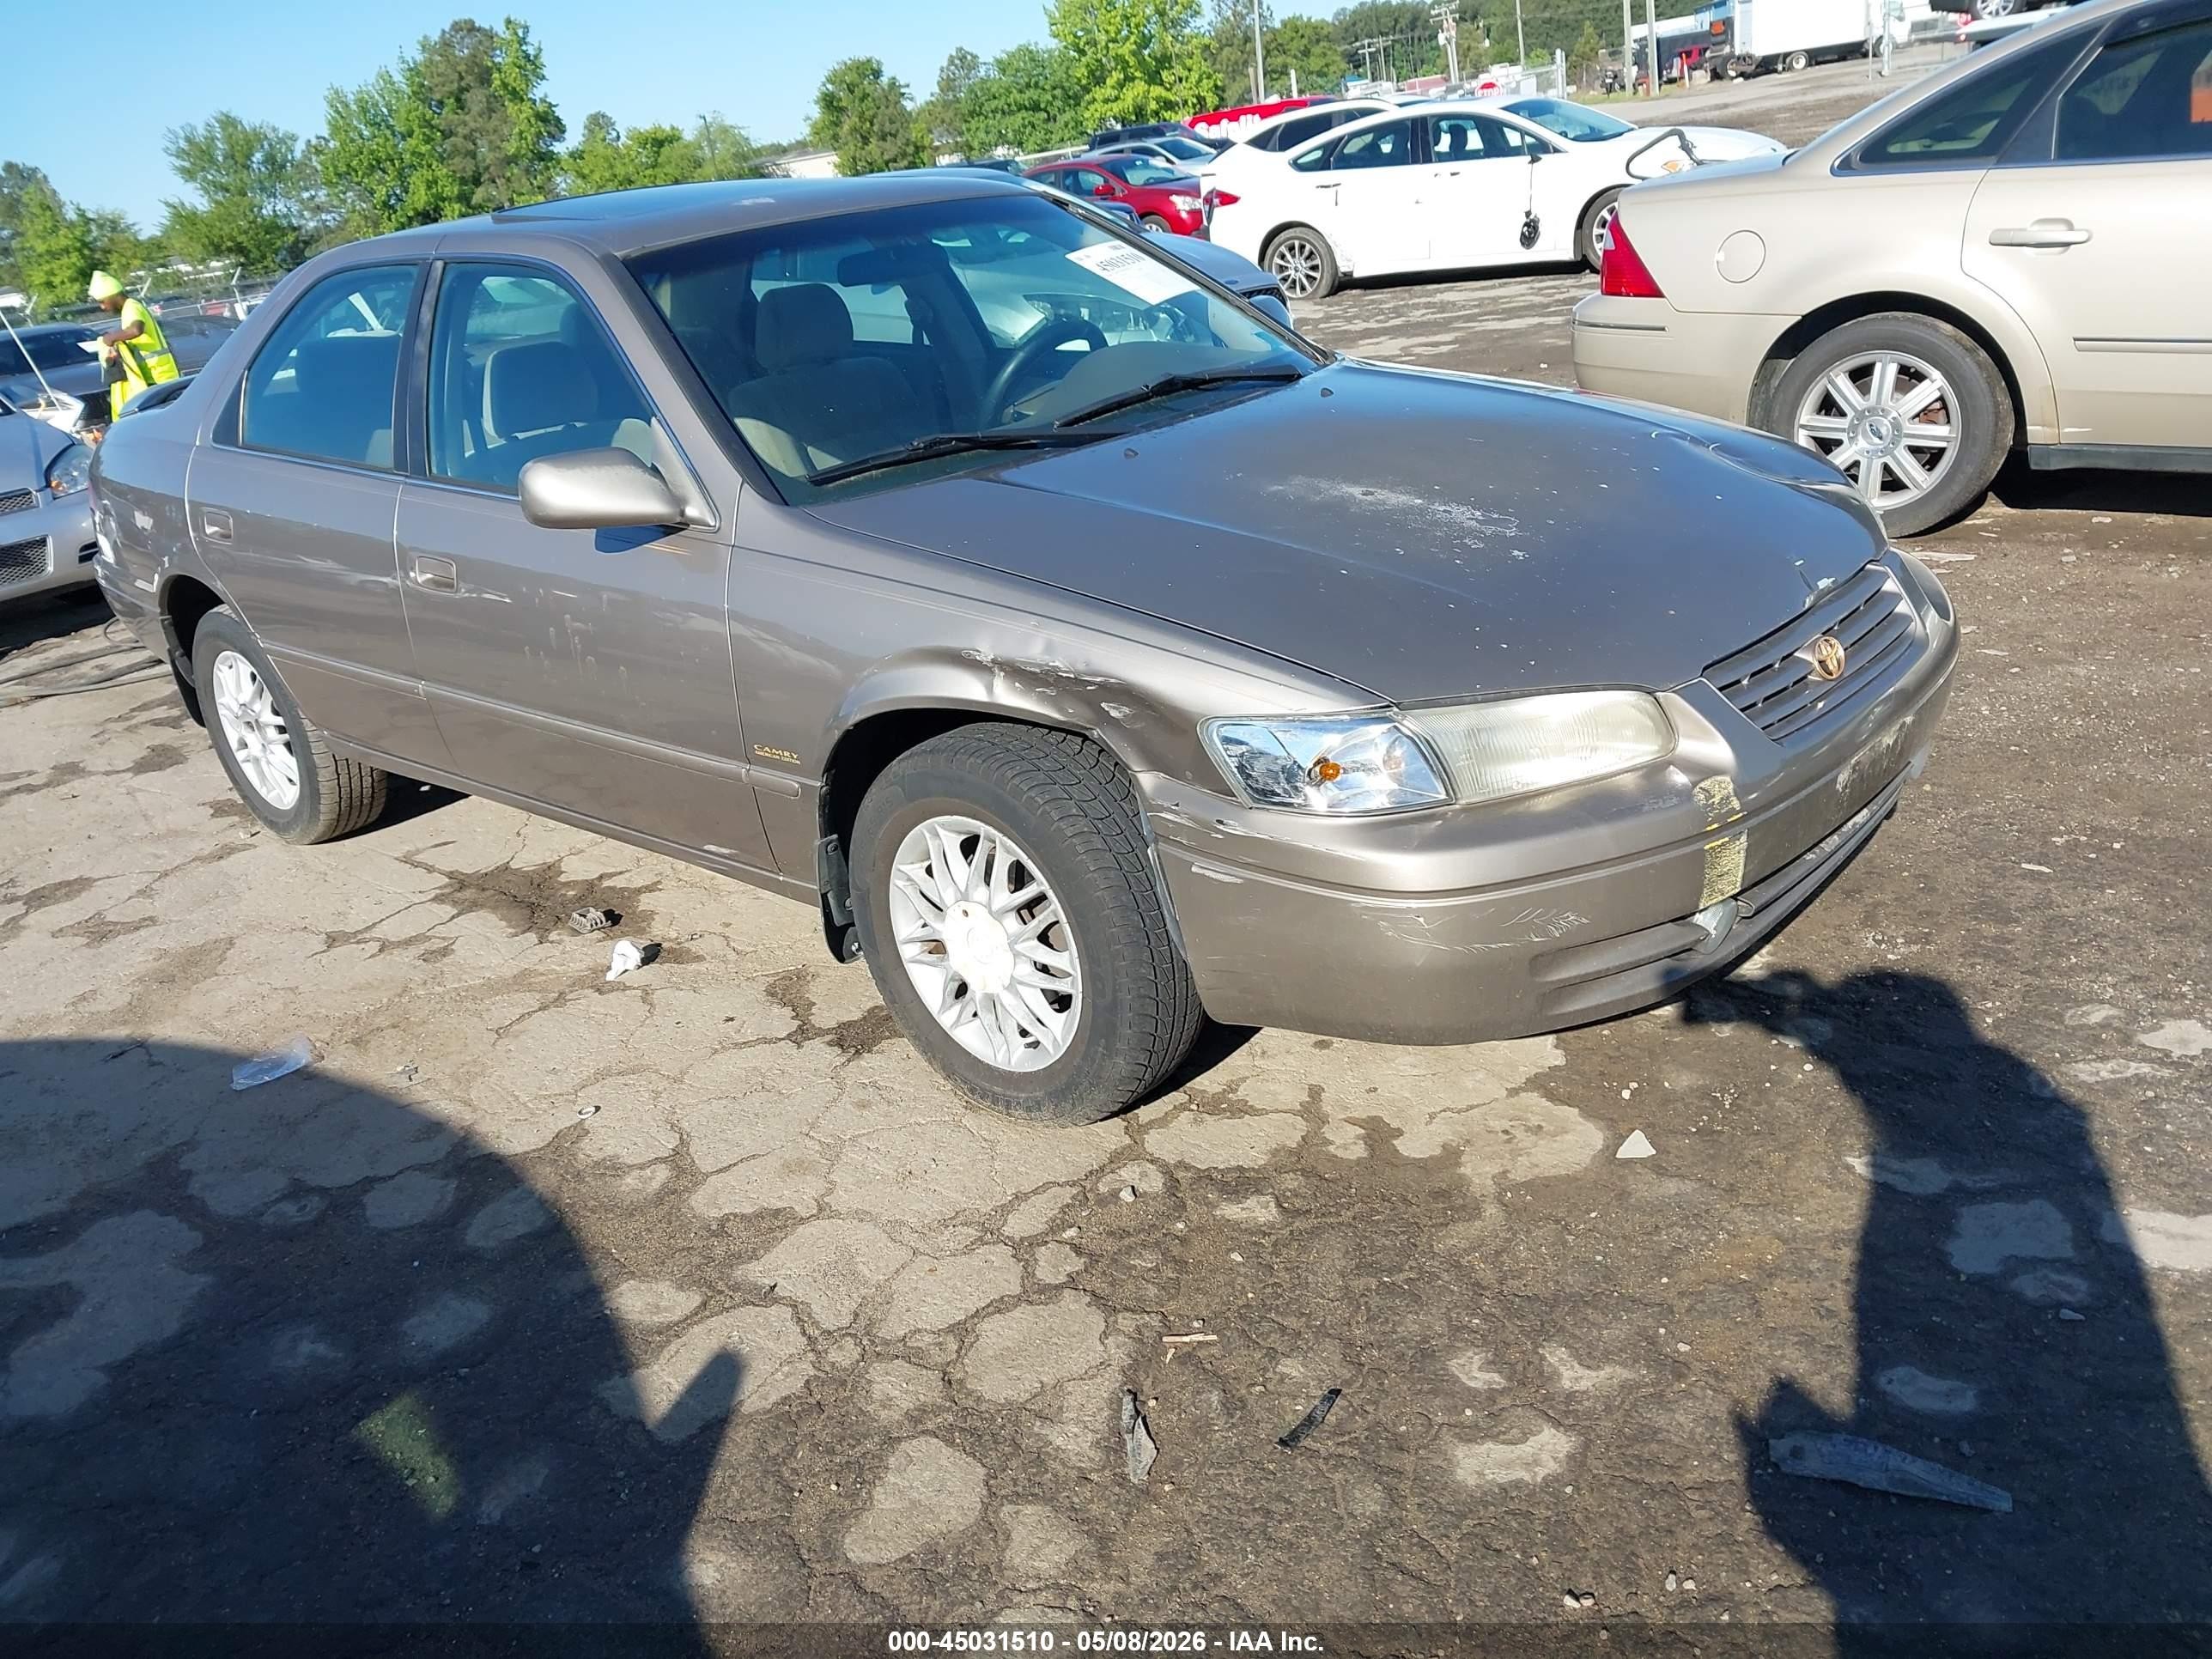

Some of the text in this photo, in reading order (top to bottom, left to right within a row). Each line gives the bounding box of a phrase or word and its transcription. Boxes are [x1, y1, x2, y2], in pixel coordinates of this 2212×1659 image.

[1194, 113, 1261, 138] Safelit
[1096, 252, 1146, 271] 45031510
[753, 744, 799, 759] CAMRY
